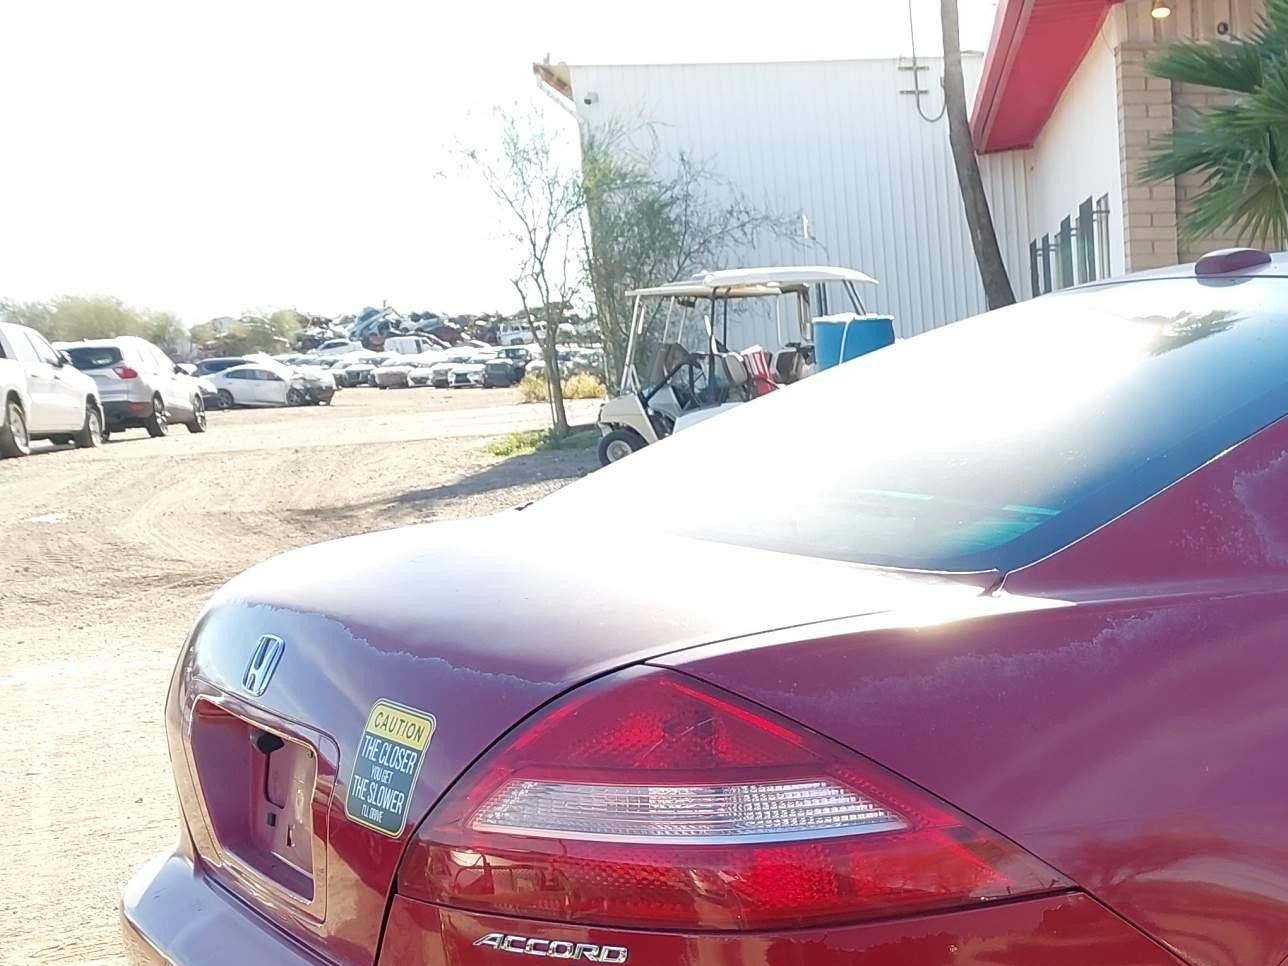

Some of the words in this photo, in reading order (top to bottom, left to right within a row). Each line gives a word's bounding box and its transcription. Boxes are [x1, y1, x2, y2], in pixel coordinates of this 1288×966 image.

[374, 711, 426, 743] CAUTION
[361, 735, 379, 762] THE
[379, 742, 418, 775] CLOSER
[370, 765, 382, 781] YOU
[381, 769, 394, 784] GET
[352, 775, 369, 800] THE
[367, 782, 406, 815] SLOWER
[472, 933, 628, 963] ACCORD
